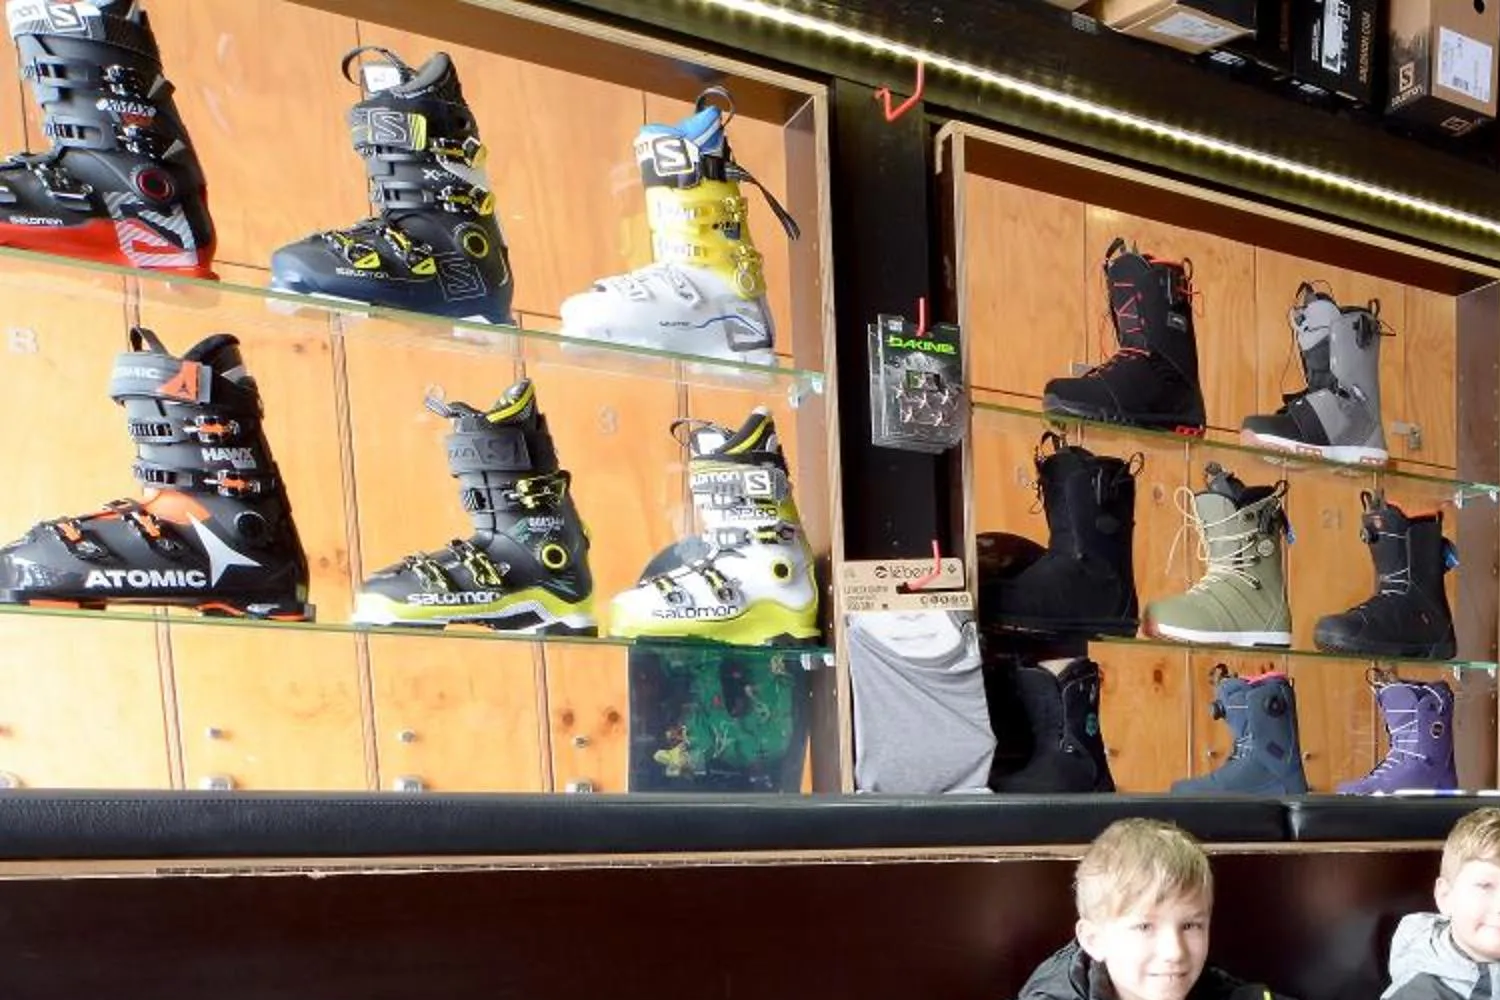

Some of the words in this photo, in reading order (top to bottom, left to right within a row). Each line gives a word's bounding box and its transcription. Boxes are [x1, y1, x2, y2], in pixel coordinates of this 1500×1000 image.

[887, 335, 957, 354] DAKINE
[201, 447, 254, 462] HAWX
[85, 569, 207, 588] ATOMIC
